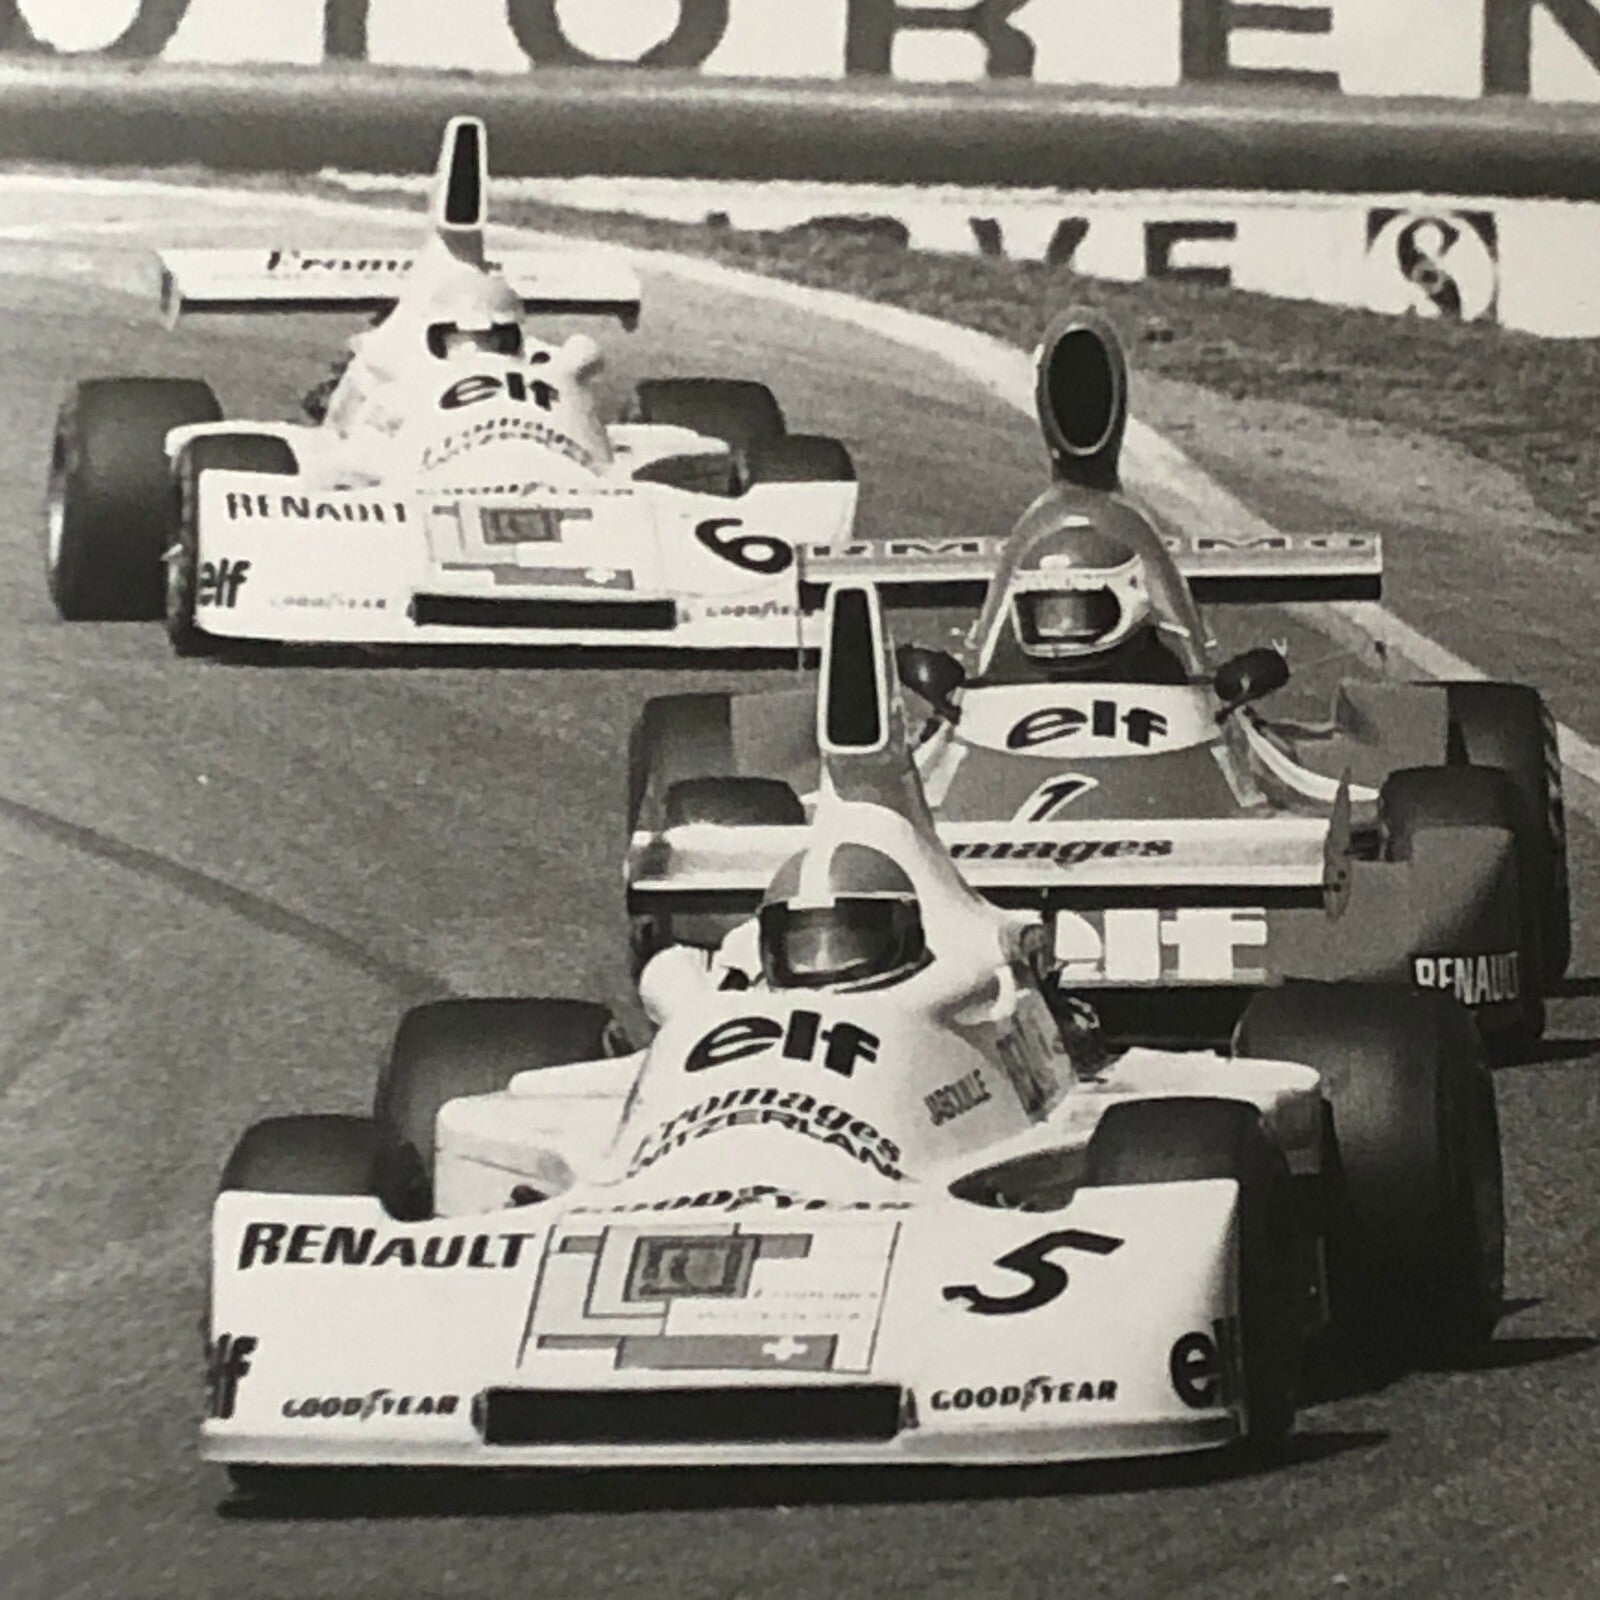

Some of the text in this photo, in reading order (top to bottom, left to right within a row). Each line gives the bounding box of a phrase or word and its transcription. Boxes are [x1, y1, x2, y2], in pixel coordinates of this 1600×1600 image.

[440, 371, 561, 412] elf
[694, 517, 794, 575] 6
[1006, 699, 1168, 750] elf
[949, 840, 1174, 872] mages
[685, 1010, 880, 1078] elf
[237, 1221, 537, 1271] RENAULT
[942, 1229, 1126, 1316] 5
[203, 1332, 259, 1420] lf
[930, 1376, 1119, 1412] GOODYEAR
[281, 1388, 460, 1422] GOODYEAR
